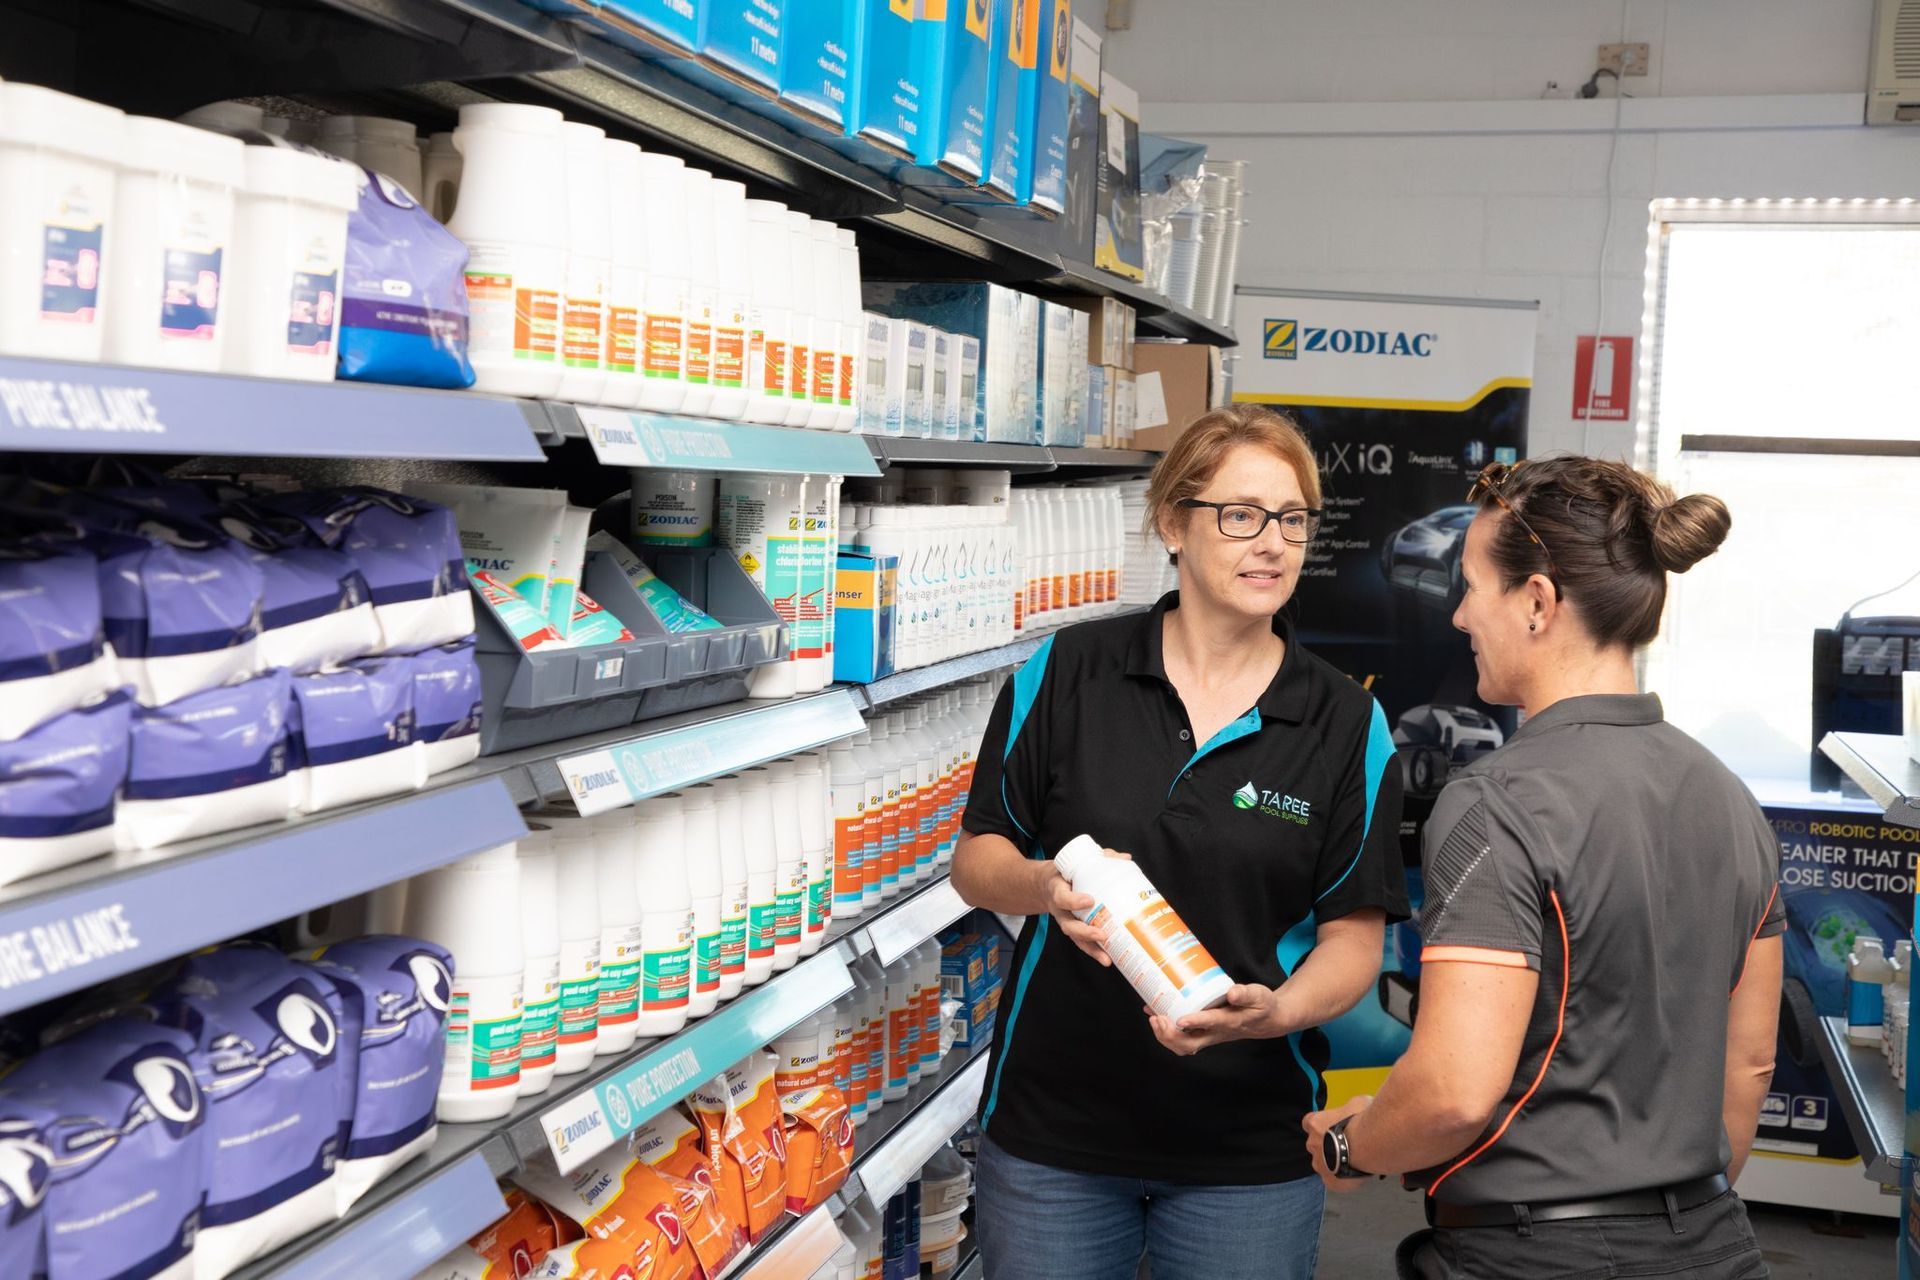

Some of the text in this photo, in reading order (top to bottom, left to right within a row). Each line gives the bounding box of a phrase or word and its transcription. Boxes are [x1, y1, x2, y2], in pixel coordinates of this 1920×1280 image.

[759, 43, 777, 65] metre
[823, 79, 846, 104] 11 metre
[0, 378, 167, 434] PURE BALANCE
[1577, 408, 1625, 418] EXNGUISHER
[649, 515, 698, 525] ZODIAC
[471, 557, 509, 571] DIAC
[835, 588, 863, 599] enser
[1260, 805, 1280, 817] POOL
[1261, 790, 1311, 817] TAREE
[1809, 822, 1877, 838] ROBOTIC
[1880, 827, 1920, 842] POOL
[1781, 842, 1847, 864] EANER
[1852, 847, 1902, 869] THAT
[1779, 867, 1824, 887] OSE
[31, 904, 140, 975] BALANCE
[626, 1047, 702, 1112] PURE PROTECTION
[731, 1080, 748, 1097] DIAC
[776, 1079, 800, 1087] natural
[1803, 1100, 1817, 1116] 3
[564, 1110, 602, 1143] ZODIAC
